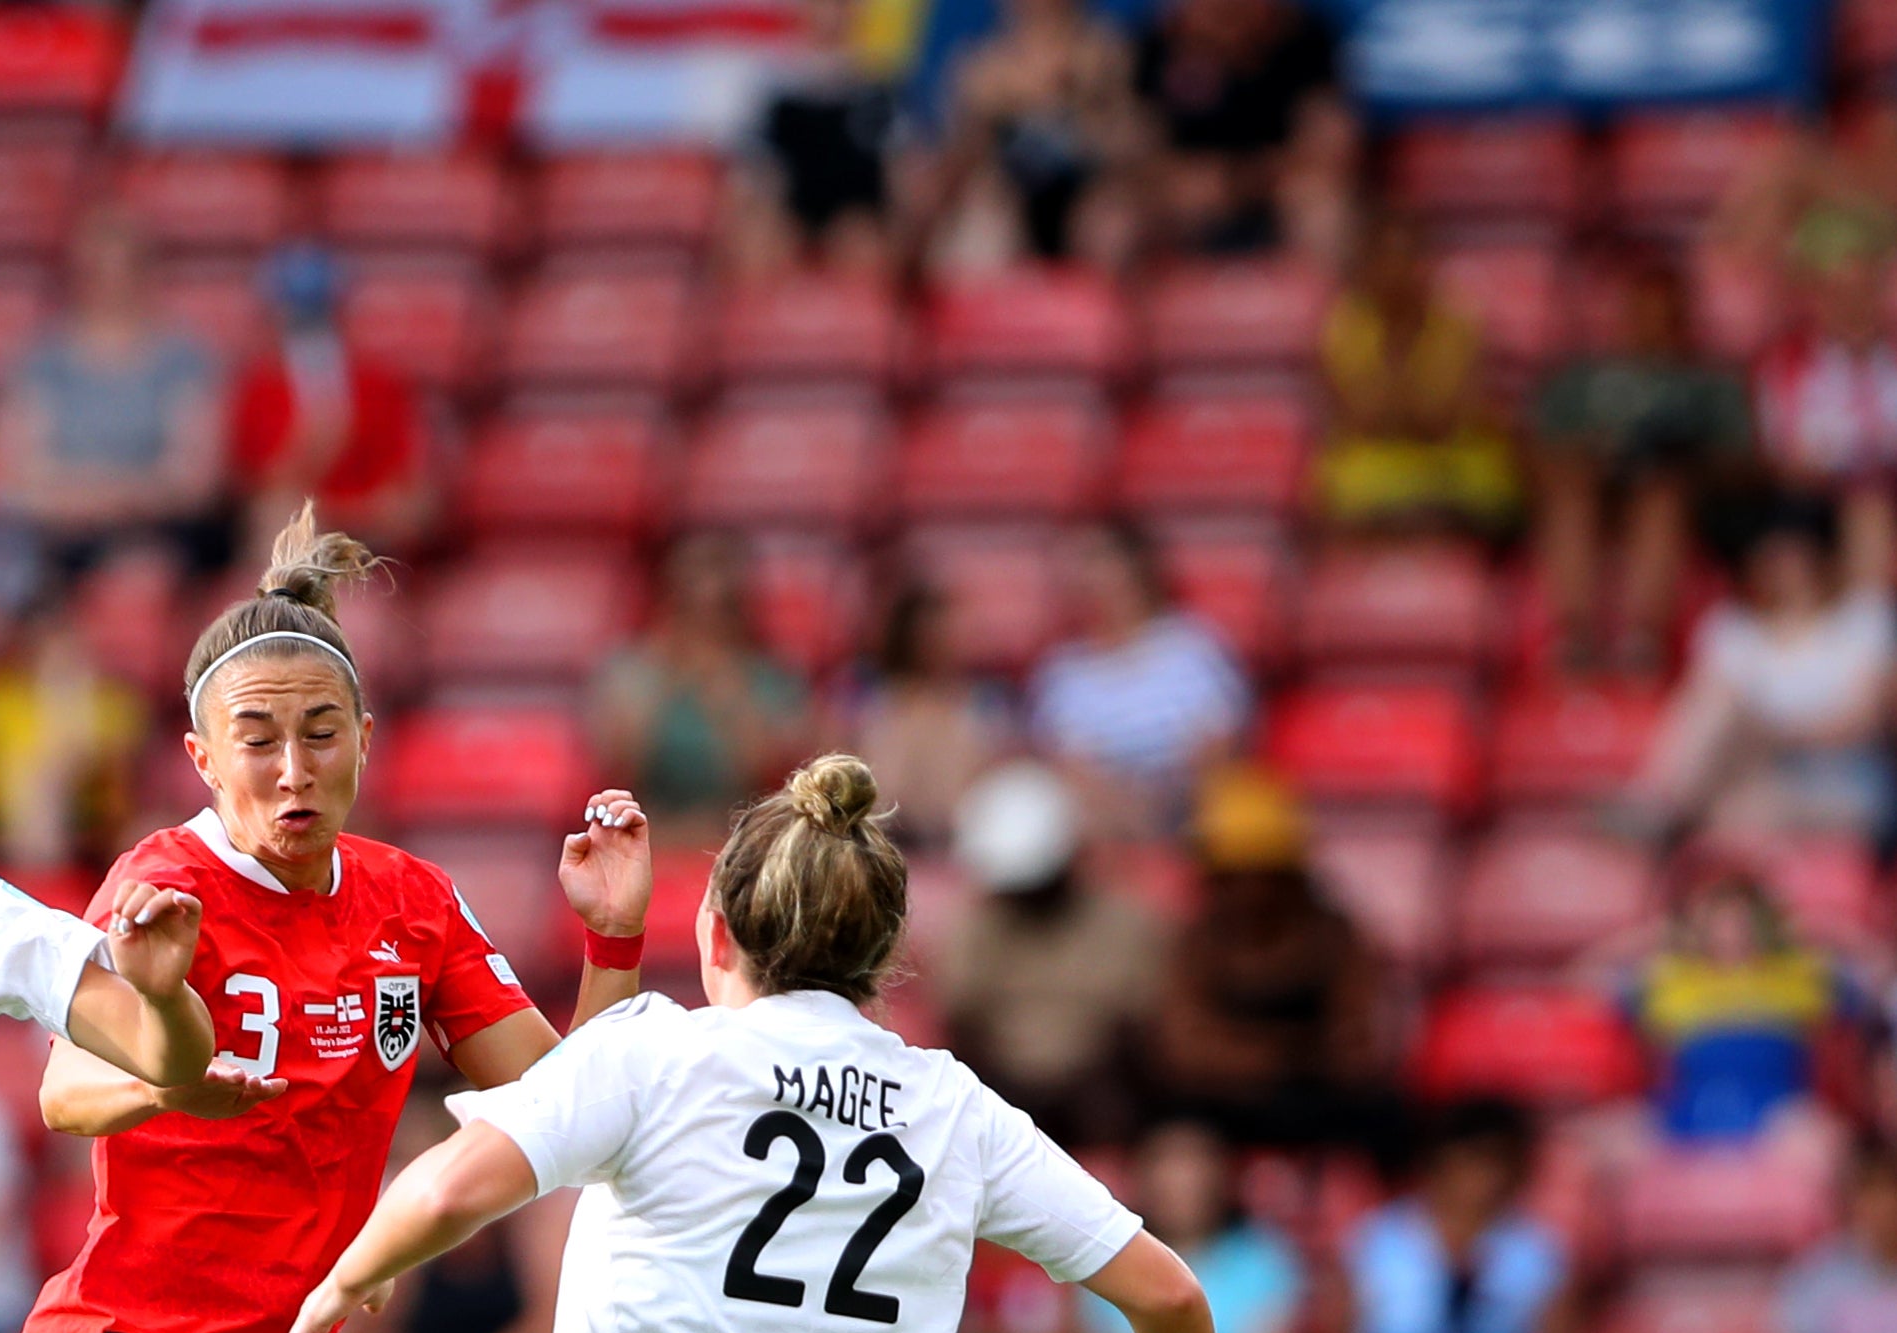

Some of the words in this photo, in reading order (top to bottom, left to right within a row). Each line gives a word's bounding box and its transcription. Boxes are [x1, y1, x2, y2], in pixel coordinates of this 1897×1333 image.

[225, 972, 280, 1078] 3
[773, 1063, 907, 1132] MAGEE
[723, 1109, 925, 1324] 22
